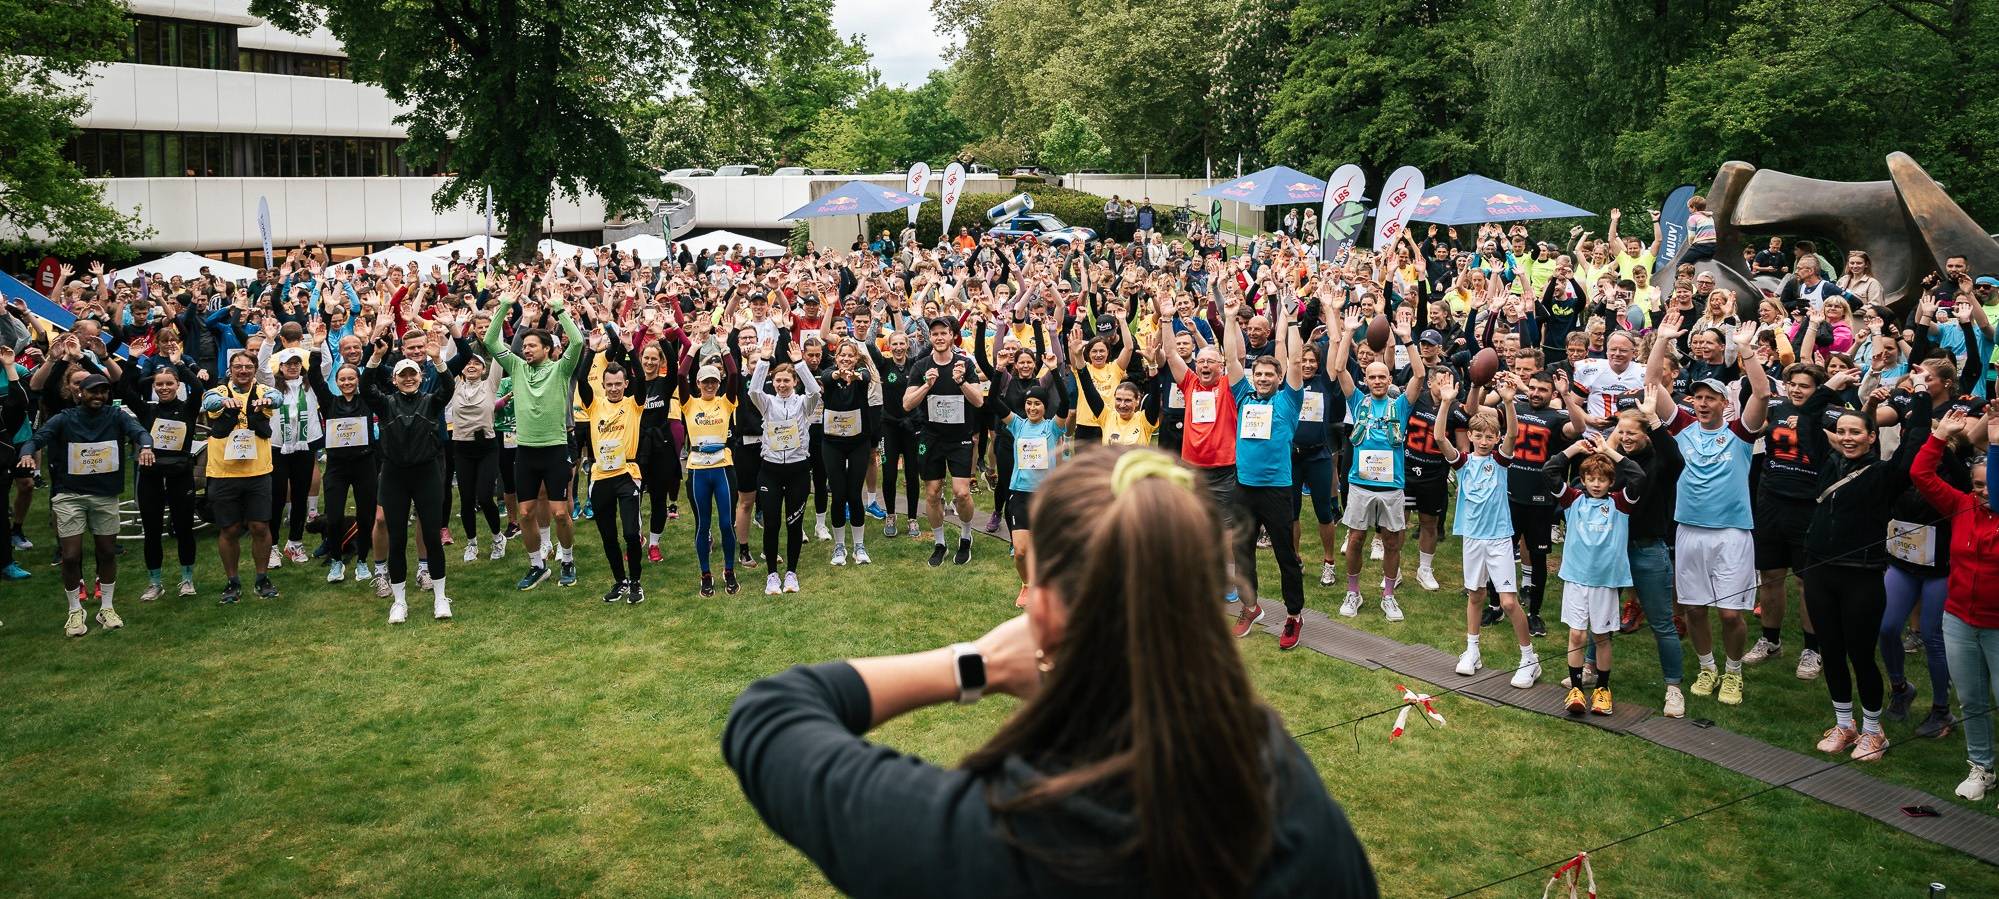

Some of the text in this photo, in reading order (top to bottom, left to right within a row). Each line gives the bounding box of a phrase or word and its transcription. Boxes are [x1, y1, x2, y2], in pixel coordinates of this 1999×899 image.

[912, 174, 922, 184] LBS
[947, 175, 957, 186] LBS
[945, 195, 955, 205] LBS
[1334, 189, 1350, 205] LBS
[1389, 191, 1407, 208] LBS
[1383, 221, 1400, 239] LBS
